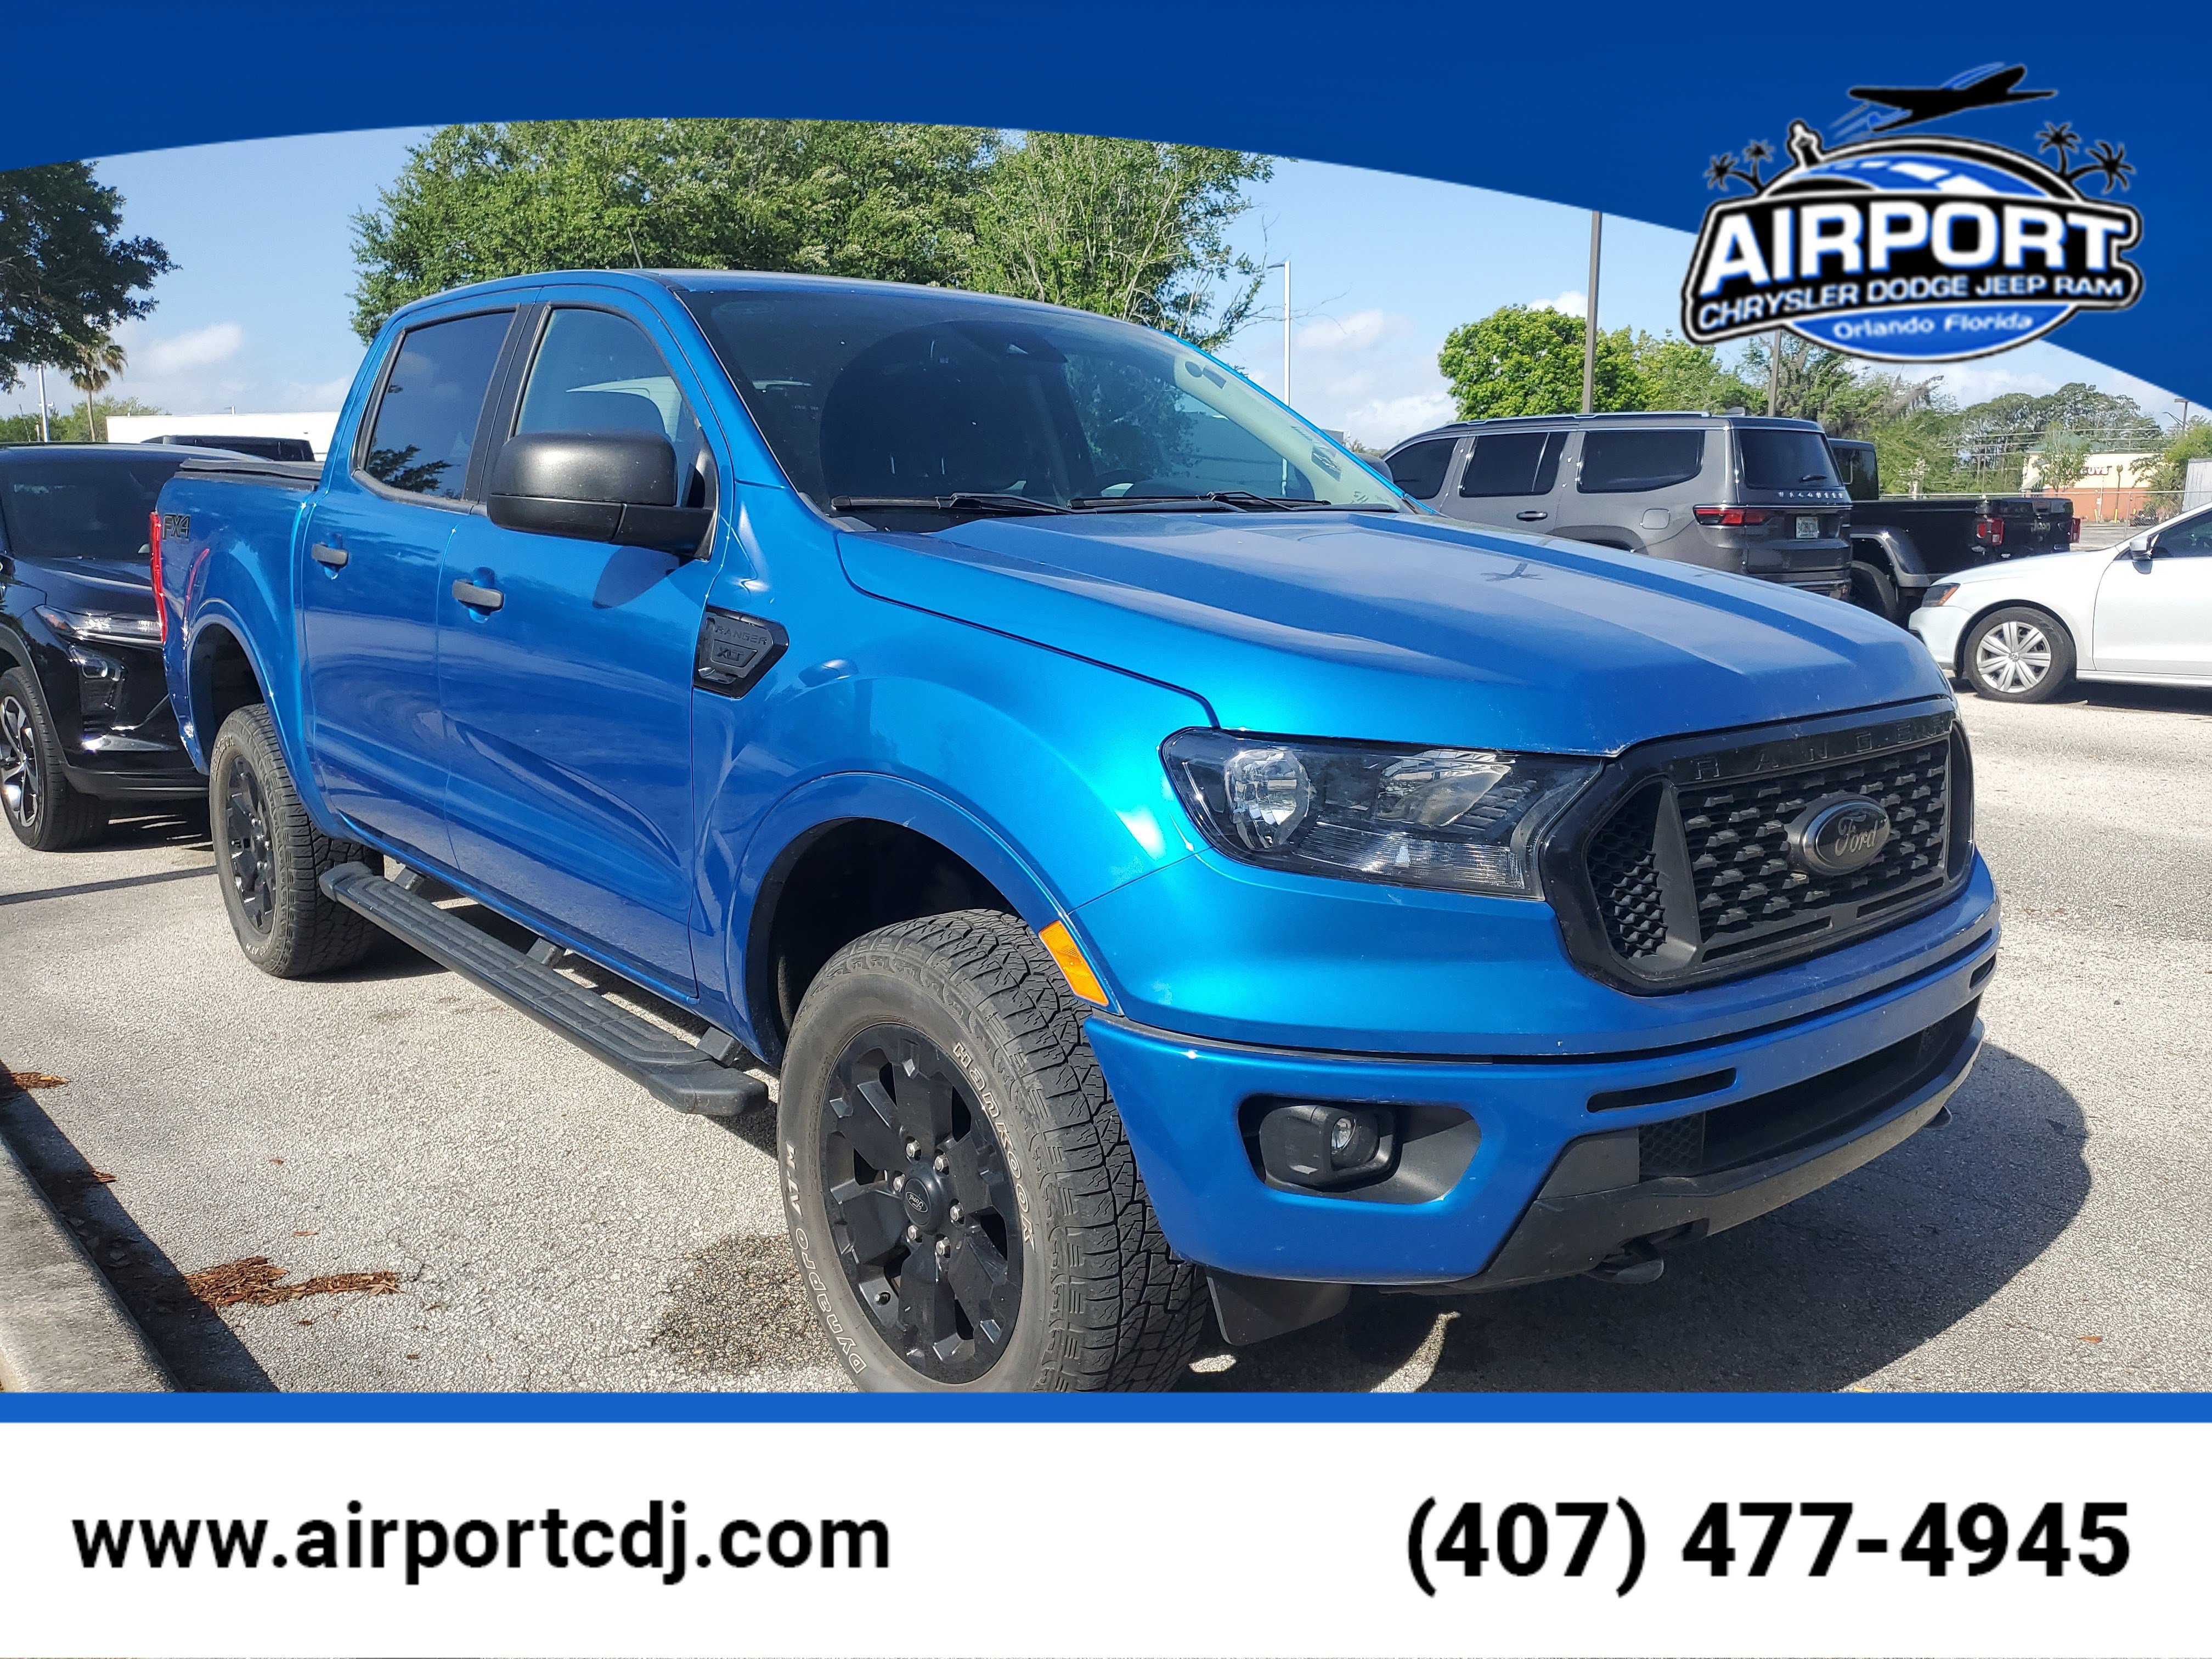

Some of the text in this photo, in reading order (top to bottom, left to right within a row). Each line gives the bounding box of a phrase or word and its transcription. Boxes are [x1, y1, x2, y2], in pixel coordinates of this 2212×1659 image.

[162, 513, 191, 540] FX4
[715, 626, 768, 645] RANGER
[1835, 814, 1878, 856] Ford
[909, 1194, 924, 1210] Ford
